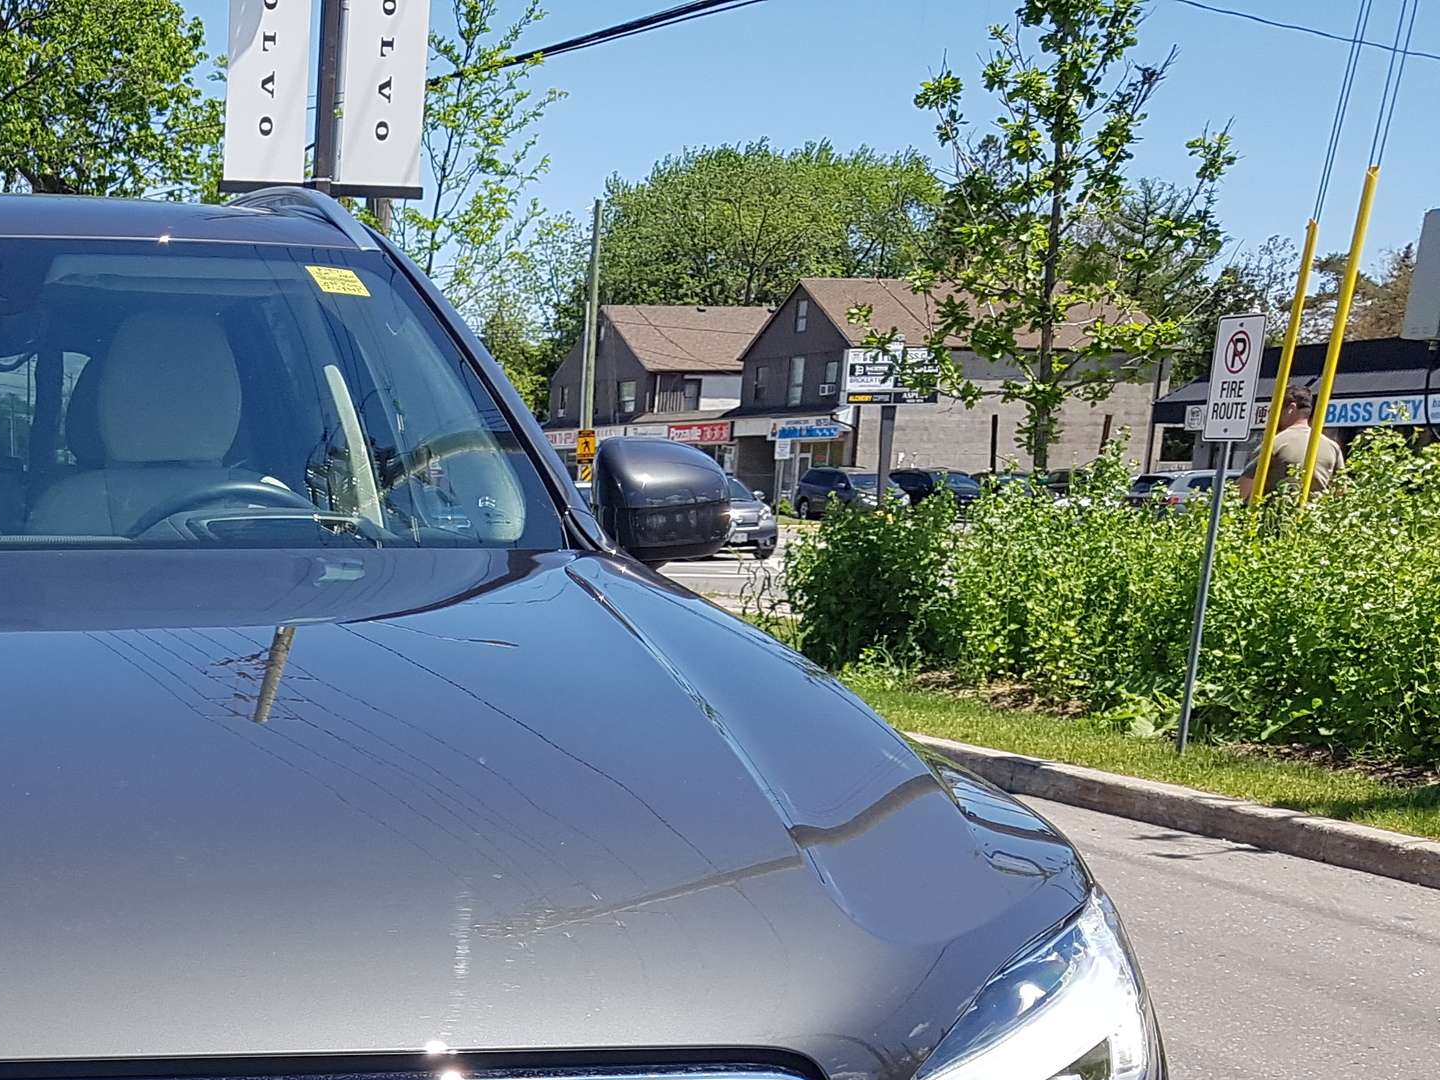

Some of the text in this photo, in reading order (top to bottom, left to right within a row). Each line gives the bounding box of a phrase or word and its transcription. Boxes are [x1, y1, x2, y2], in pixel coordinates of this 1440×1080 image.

[1220, 380, 1245, 398] FIRE
[1211, 402, 1247, 420] ROUTE
[1378, 399, 1423, 421] CY
